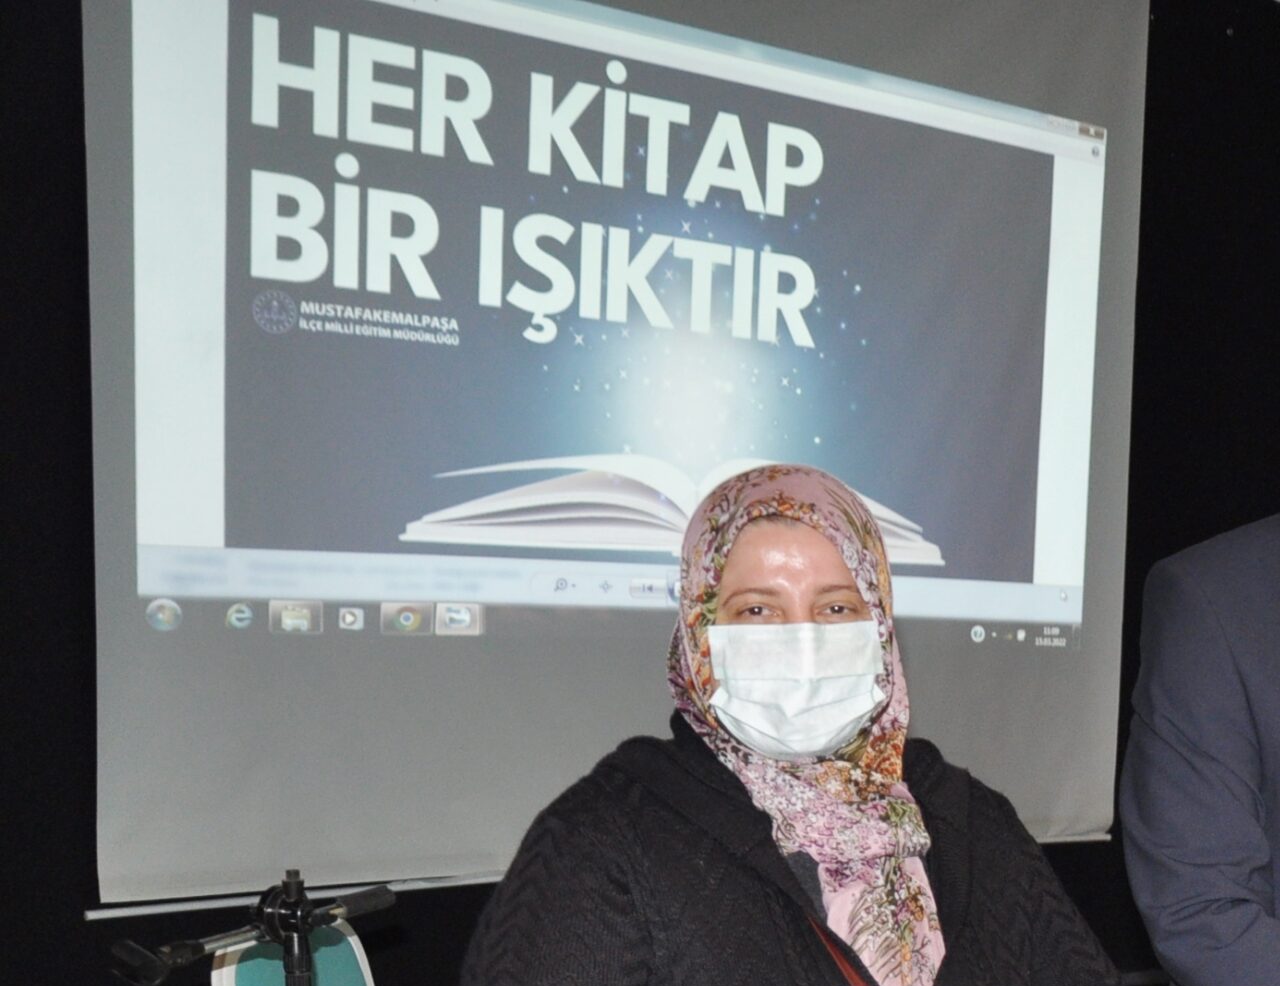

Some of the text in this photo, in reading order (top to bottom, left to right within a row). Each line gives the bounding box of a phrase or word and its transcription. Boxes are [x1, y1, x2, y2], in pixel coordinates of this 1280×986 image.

[251, 12, 825, 218] HER KİTAP
[250, 152, 816, 348] BİR IŞIKTIR
[300, 300, 460, 333] MUSTAFAKEMALPAŞA
